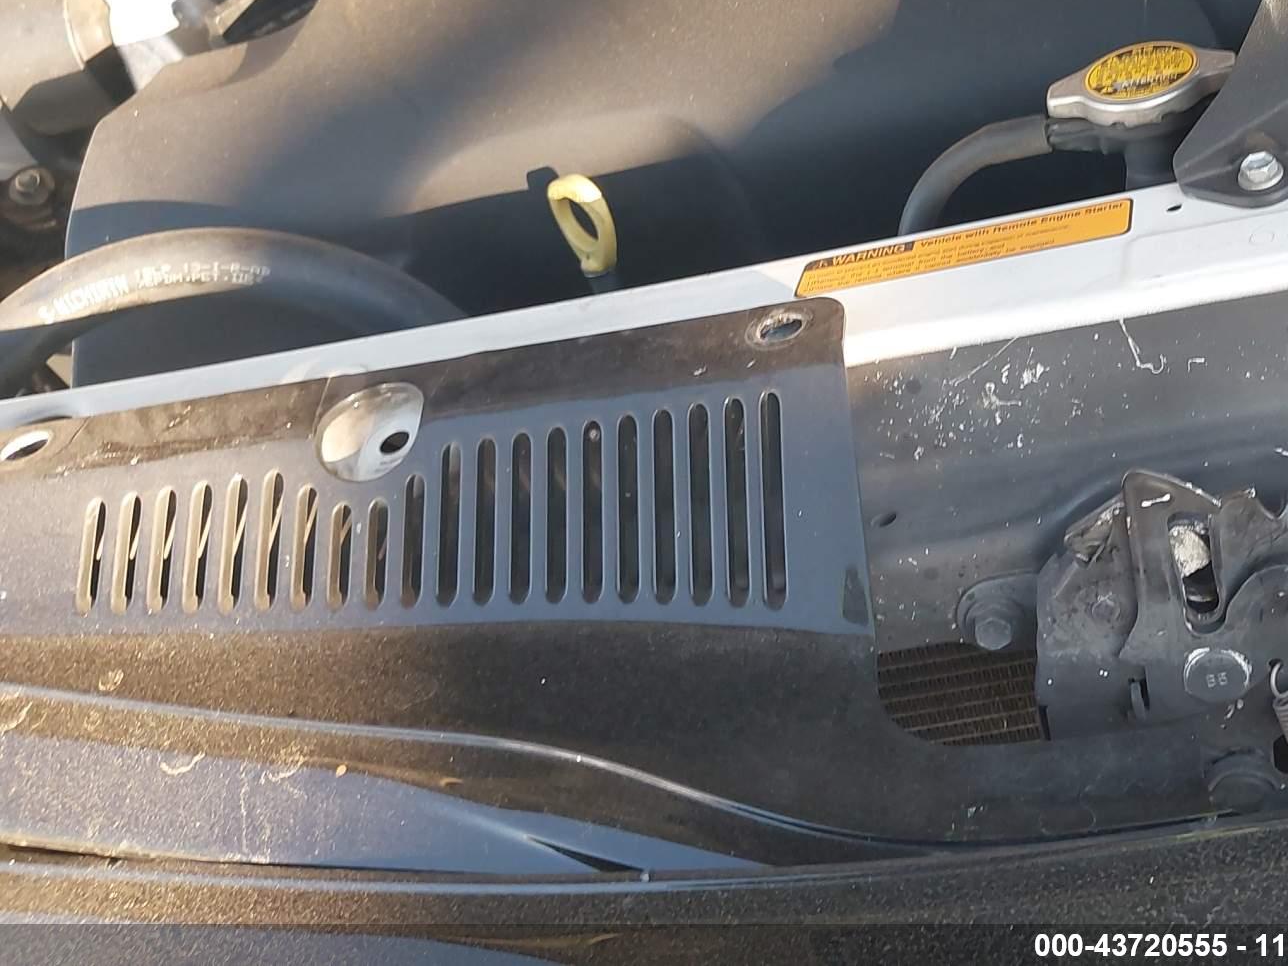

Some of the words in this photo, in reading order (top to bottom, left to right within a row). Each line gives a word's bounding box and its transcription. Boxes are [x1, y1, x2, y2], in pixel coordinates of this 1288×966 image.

[832, 244, 905, 266] WARNING
[965, 229, 988, 238] with
[993, 219, 1037, 233] Remote
[1040, 211, 1080, 224] Engine
[1084, 202, 1122, 214] Starter
